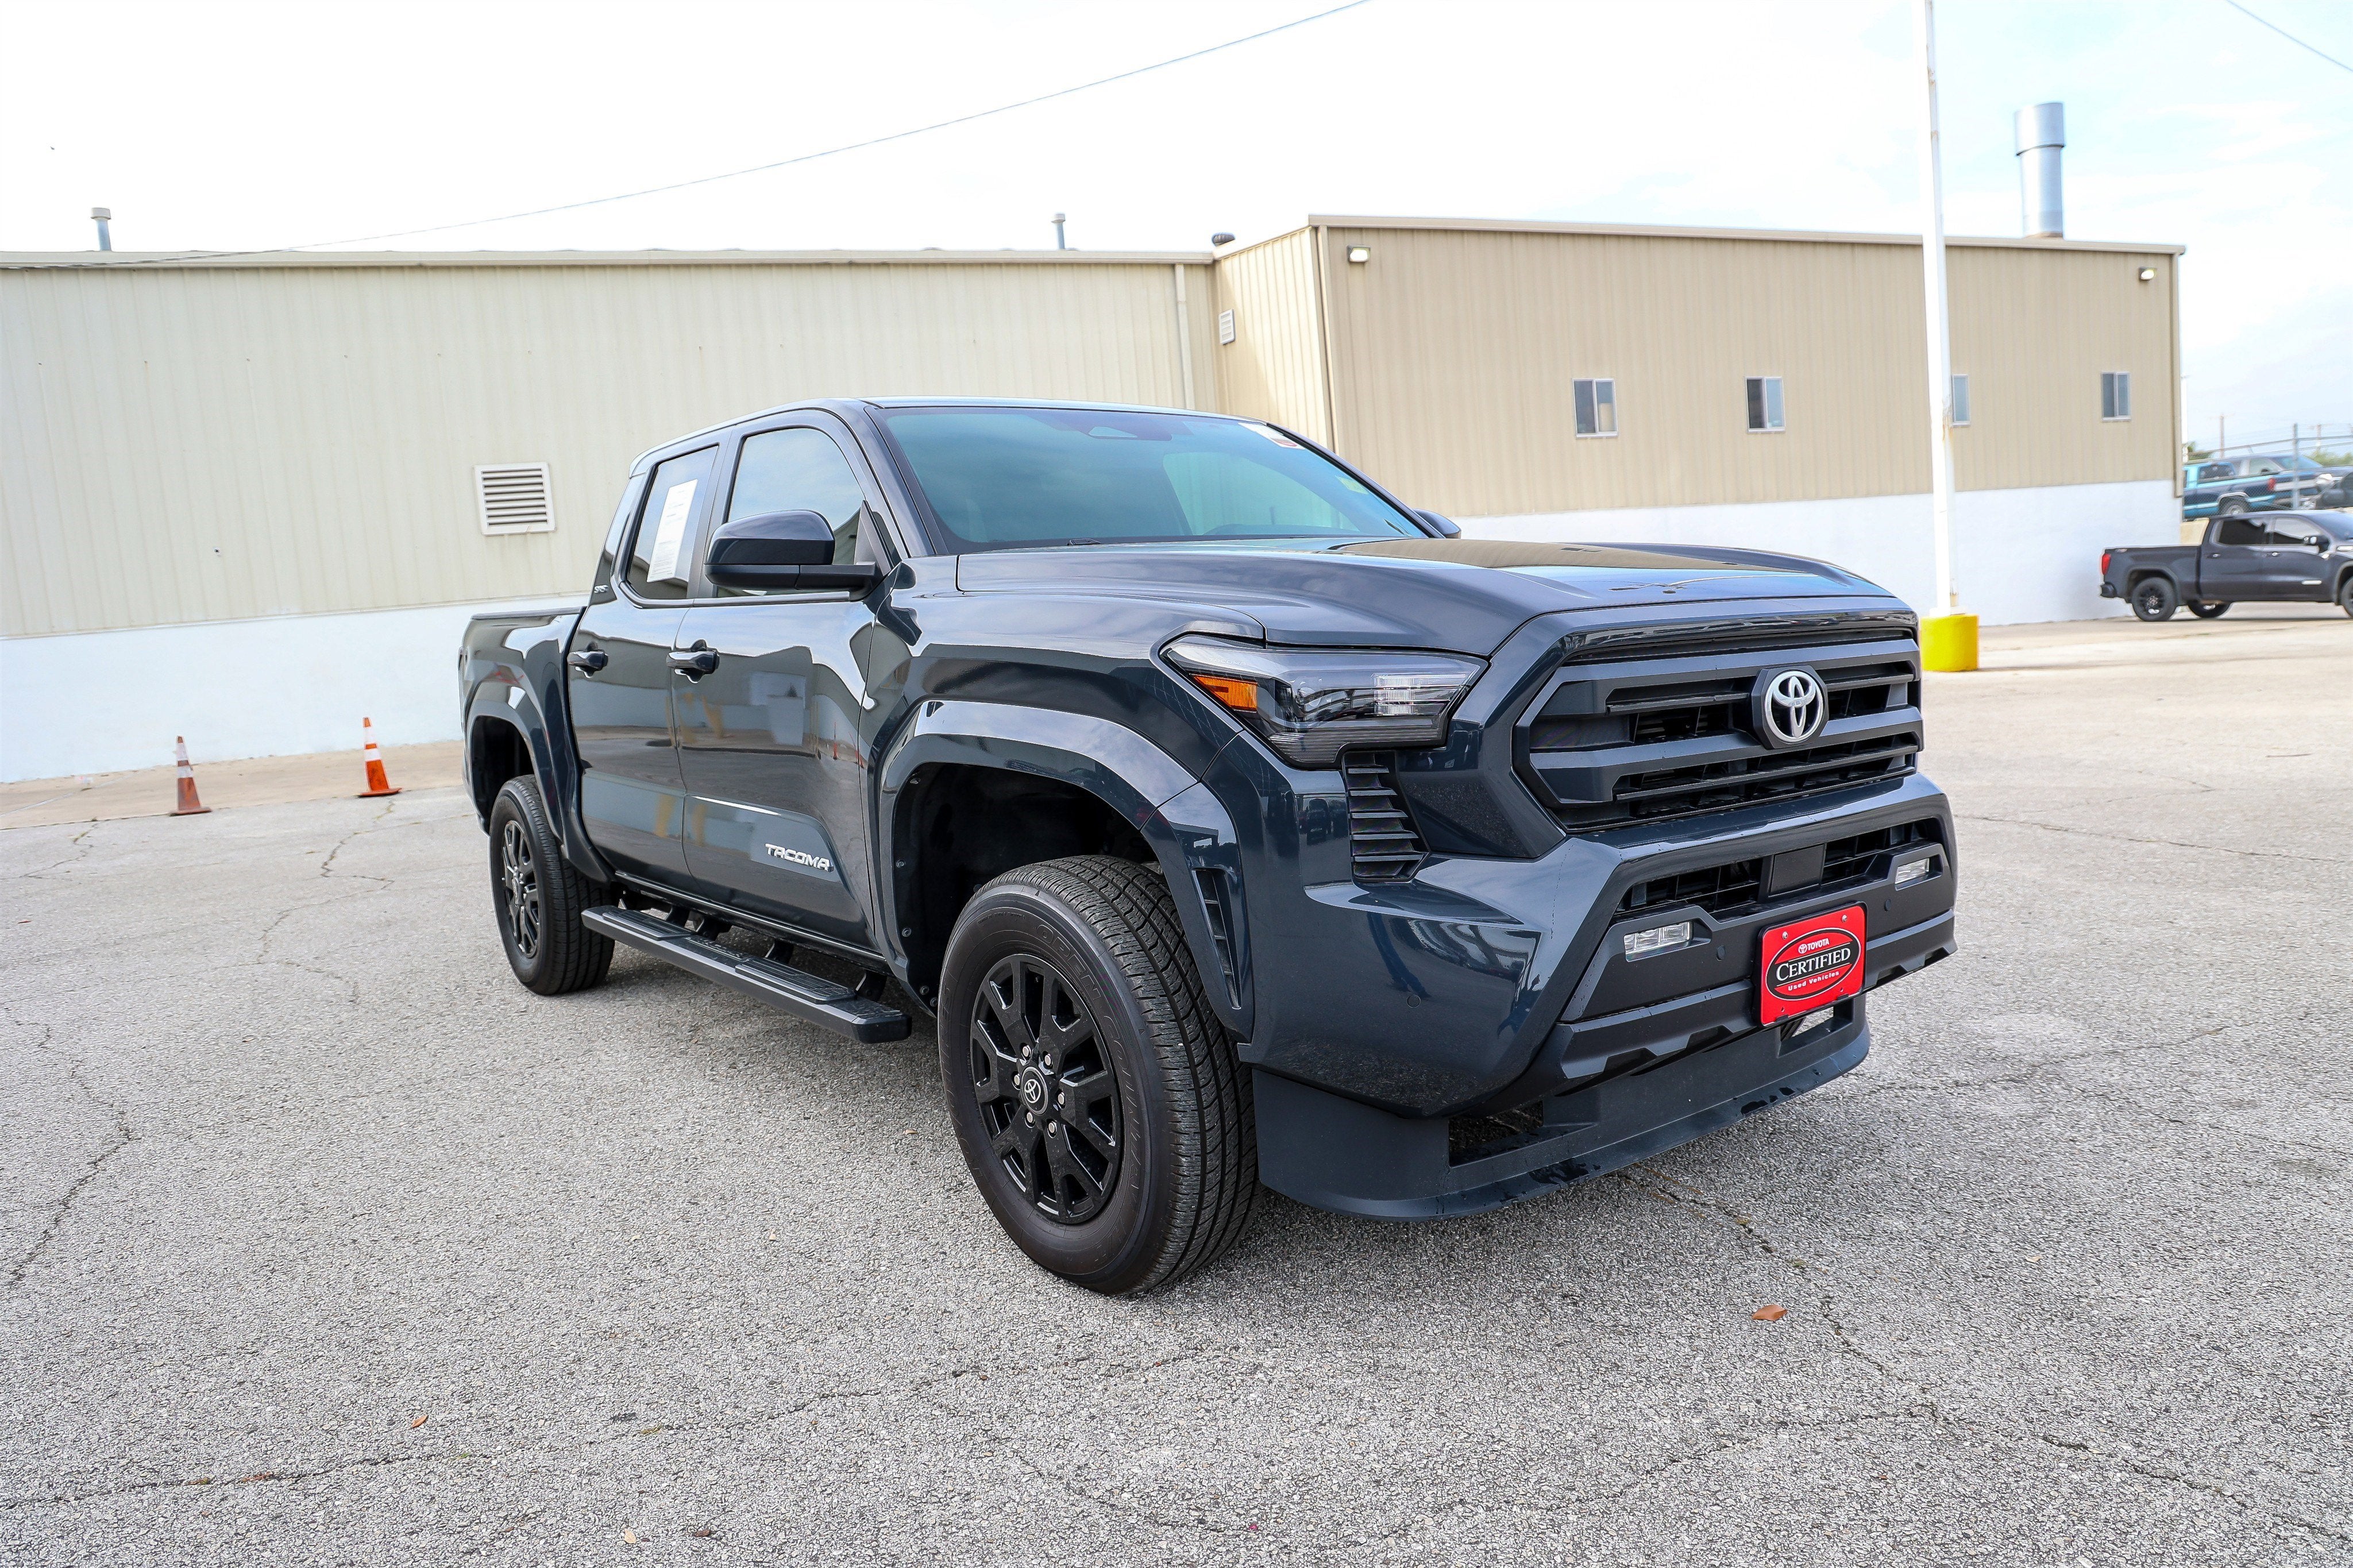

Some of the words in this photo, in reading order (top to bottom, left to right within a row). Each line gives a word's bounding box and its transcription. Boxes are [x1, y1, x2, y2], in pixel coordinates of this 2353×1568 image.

[1209, 658, 1247, 666] TACOMA
[765, 843, 833, 872] TACOMA
[1807, 938, 1830, 951] TOYOTA
[1036, 924, 1102, 1001] OPEN
[1788, 980, 1807, 991] Used
[1808, 971, 1840, 984] Vehicles
